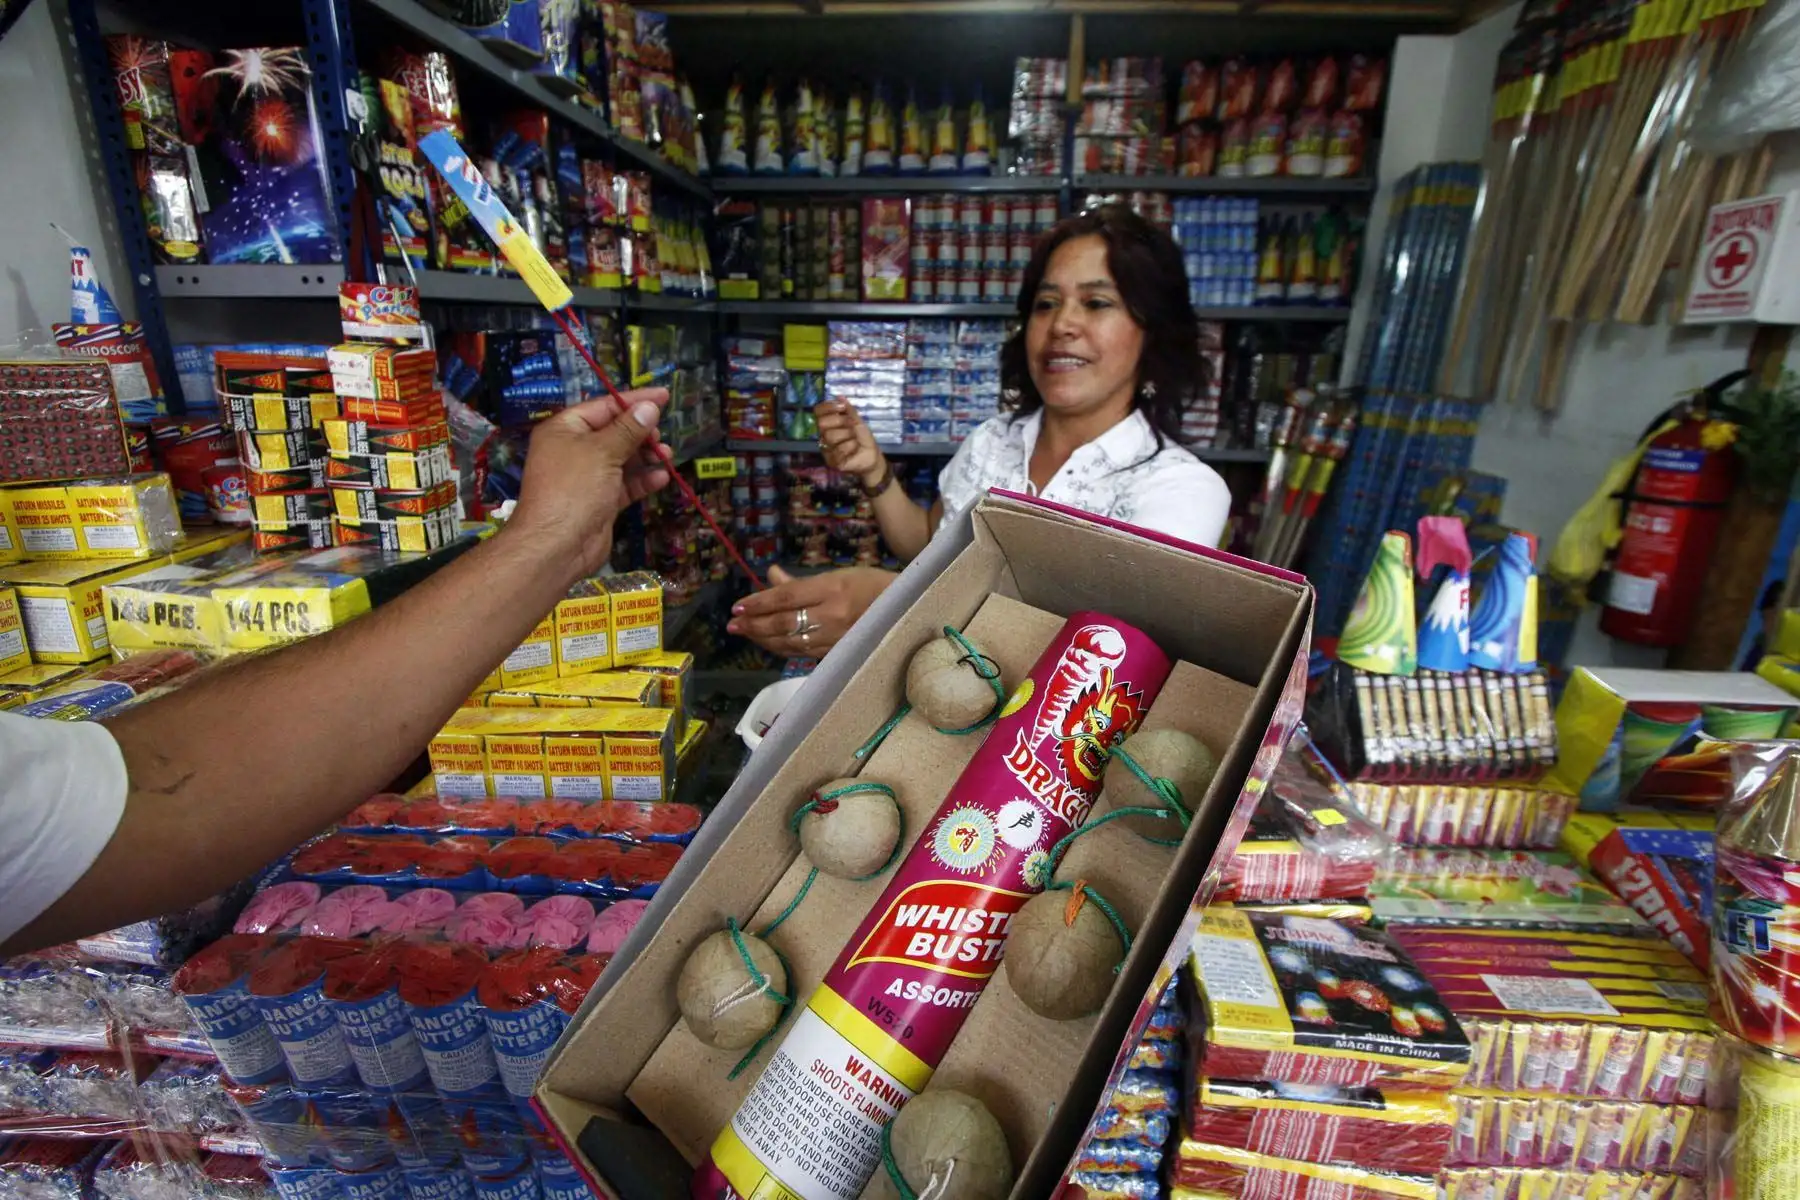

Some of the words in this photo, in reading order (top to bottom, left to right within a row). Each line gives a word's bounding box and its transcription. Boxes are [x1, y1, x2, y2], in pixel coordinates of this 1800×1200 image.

[225, 600, 265, 632] 144
[1335, 1040, 1374, 1051] MADE
[1380, 1045, 1394, 1053] IN
[1400, 1048, 1440, 1059] CHINA
[777, 1068, 813, 1107] OUTDOOR
[813, 1103, 833, 1123] USE
[785, 1059, 803, 1078] ONLY
[803, 1076, 833, 1107] UNDER
[833, 1102, 863, 1130] CLOSE
[810, 1058, 854, 1101] SHOOTS
[744, 1122, 757, 1138] GET
[768, 1092, 788, 1116] FUSE
[787, 1114, 802, 1130] ON
[776, 1084, 789, 1100] ON
[786, 1097, 794, 1108] A
[822, 1126, 858, 1158] SMOOTH
[751, 1110, 760, 1123] OF
[778, 1143, 796, 1158] DO
[795, 1155, 818, 1178] NOT
[815, 1173, 841, 1193] HOLD
[759, 1103, 773, 1120] END
[772, 1118, 801, 1146] DOWN
[800, 1144, 822, 1163] AND
[822, 1158, 845, 1181] WITH
